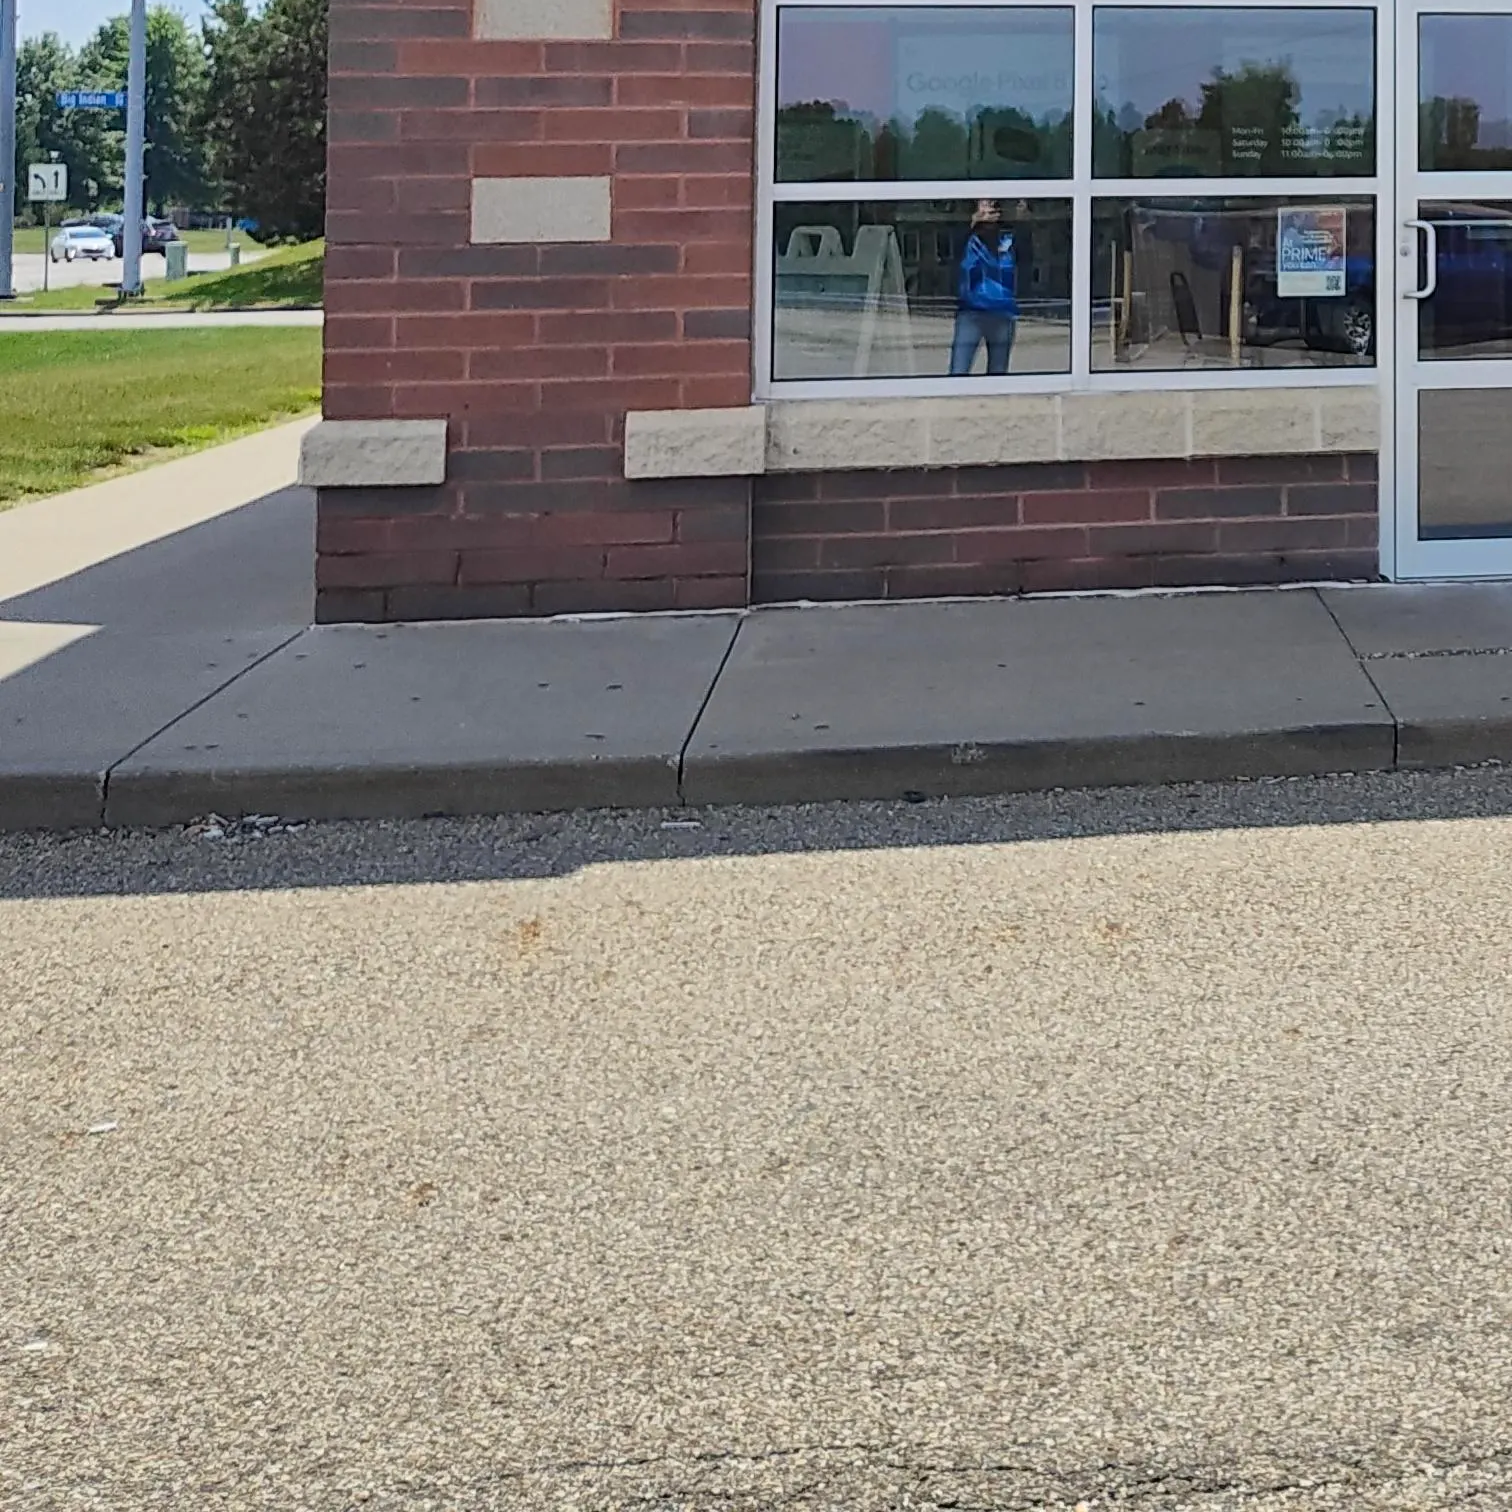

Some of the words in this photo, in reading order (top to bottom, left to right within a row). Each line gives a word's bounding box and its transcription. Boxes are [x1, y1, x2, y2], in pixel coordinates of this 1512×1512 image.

[906, 72, 991, 96] Google
[1232, 138, 1268, 148] Saturday
[1232, 150, 1262, 160] Sunday
[1282, 247, 1326, 261] PRIME
